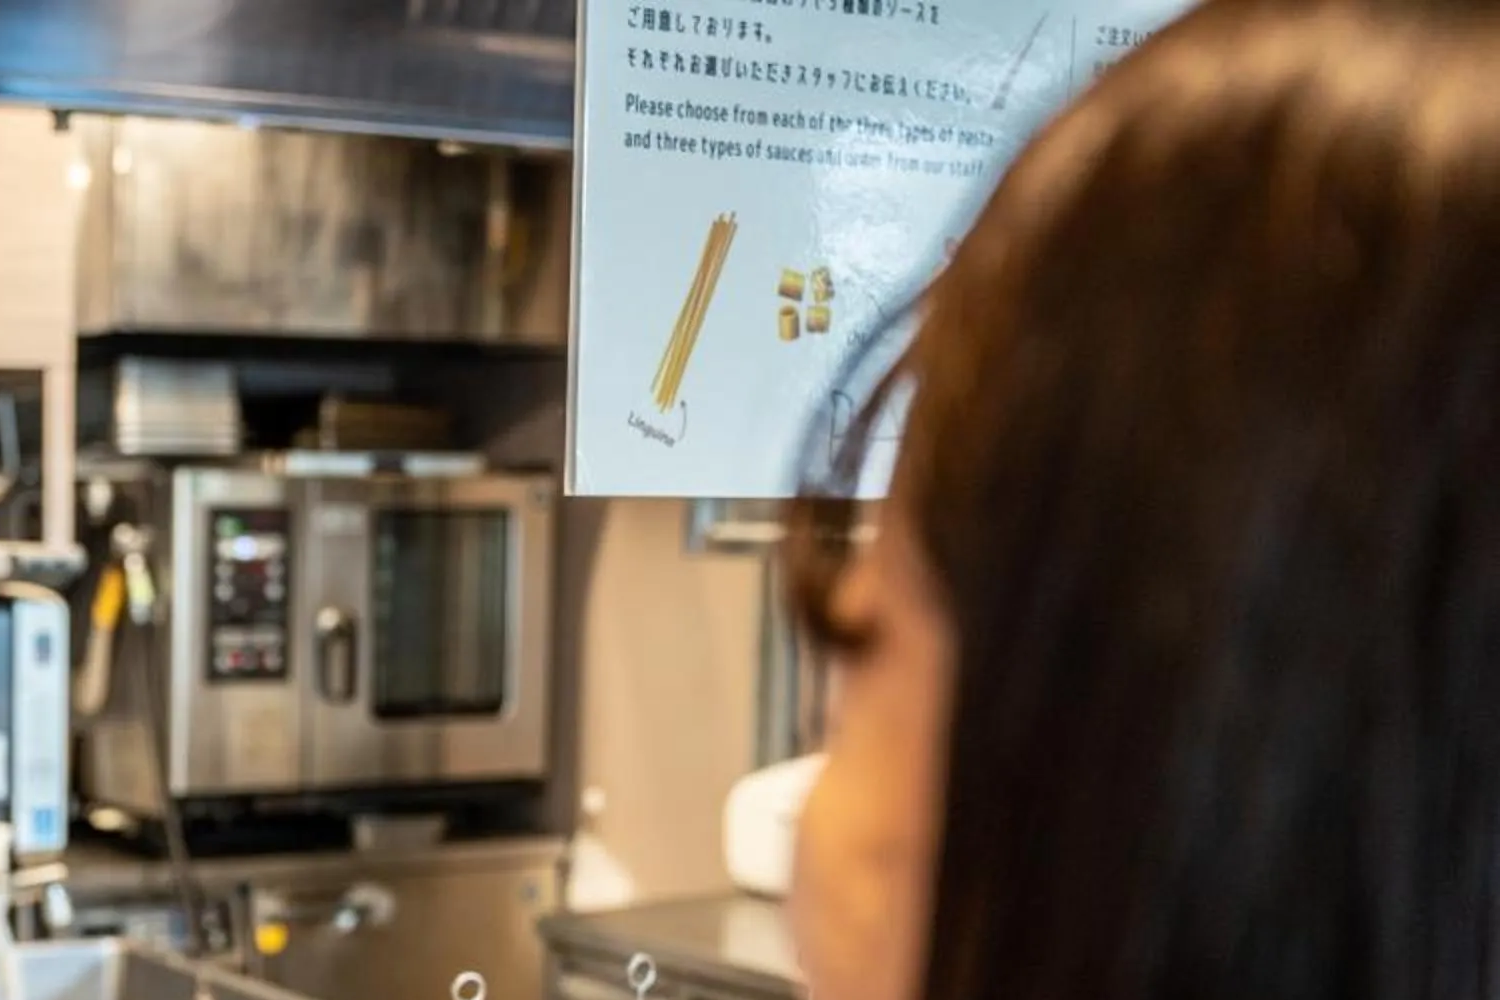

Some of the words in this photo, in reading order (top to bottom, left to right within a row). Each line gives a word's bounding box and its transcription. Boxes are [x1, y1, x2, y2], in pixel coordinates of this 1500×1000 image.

[627, 5, 772, 43] ご用意しております。
[625, 93, 673, 118] Please
[677, 100, 729, 122] choose
[733, 103, 768, 126] from
[772, 110, 806, 130] each
[809, 112, 825, 130] of
[829, 115, 852, 133] the
[939, 126, 954, 144] of
[624, 129, 651, 149] and
[656, 132, 697, 152] three
[701, 136, 742, 160] types
[745, 138, 762, 158] of
[766, 144, 813, 164] sauces
